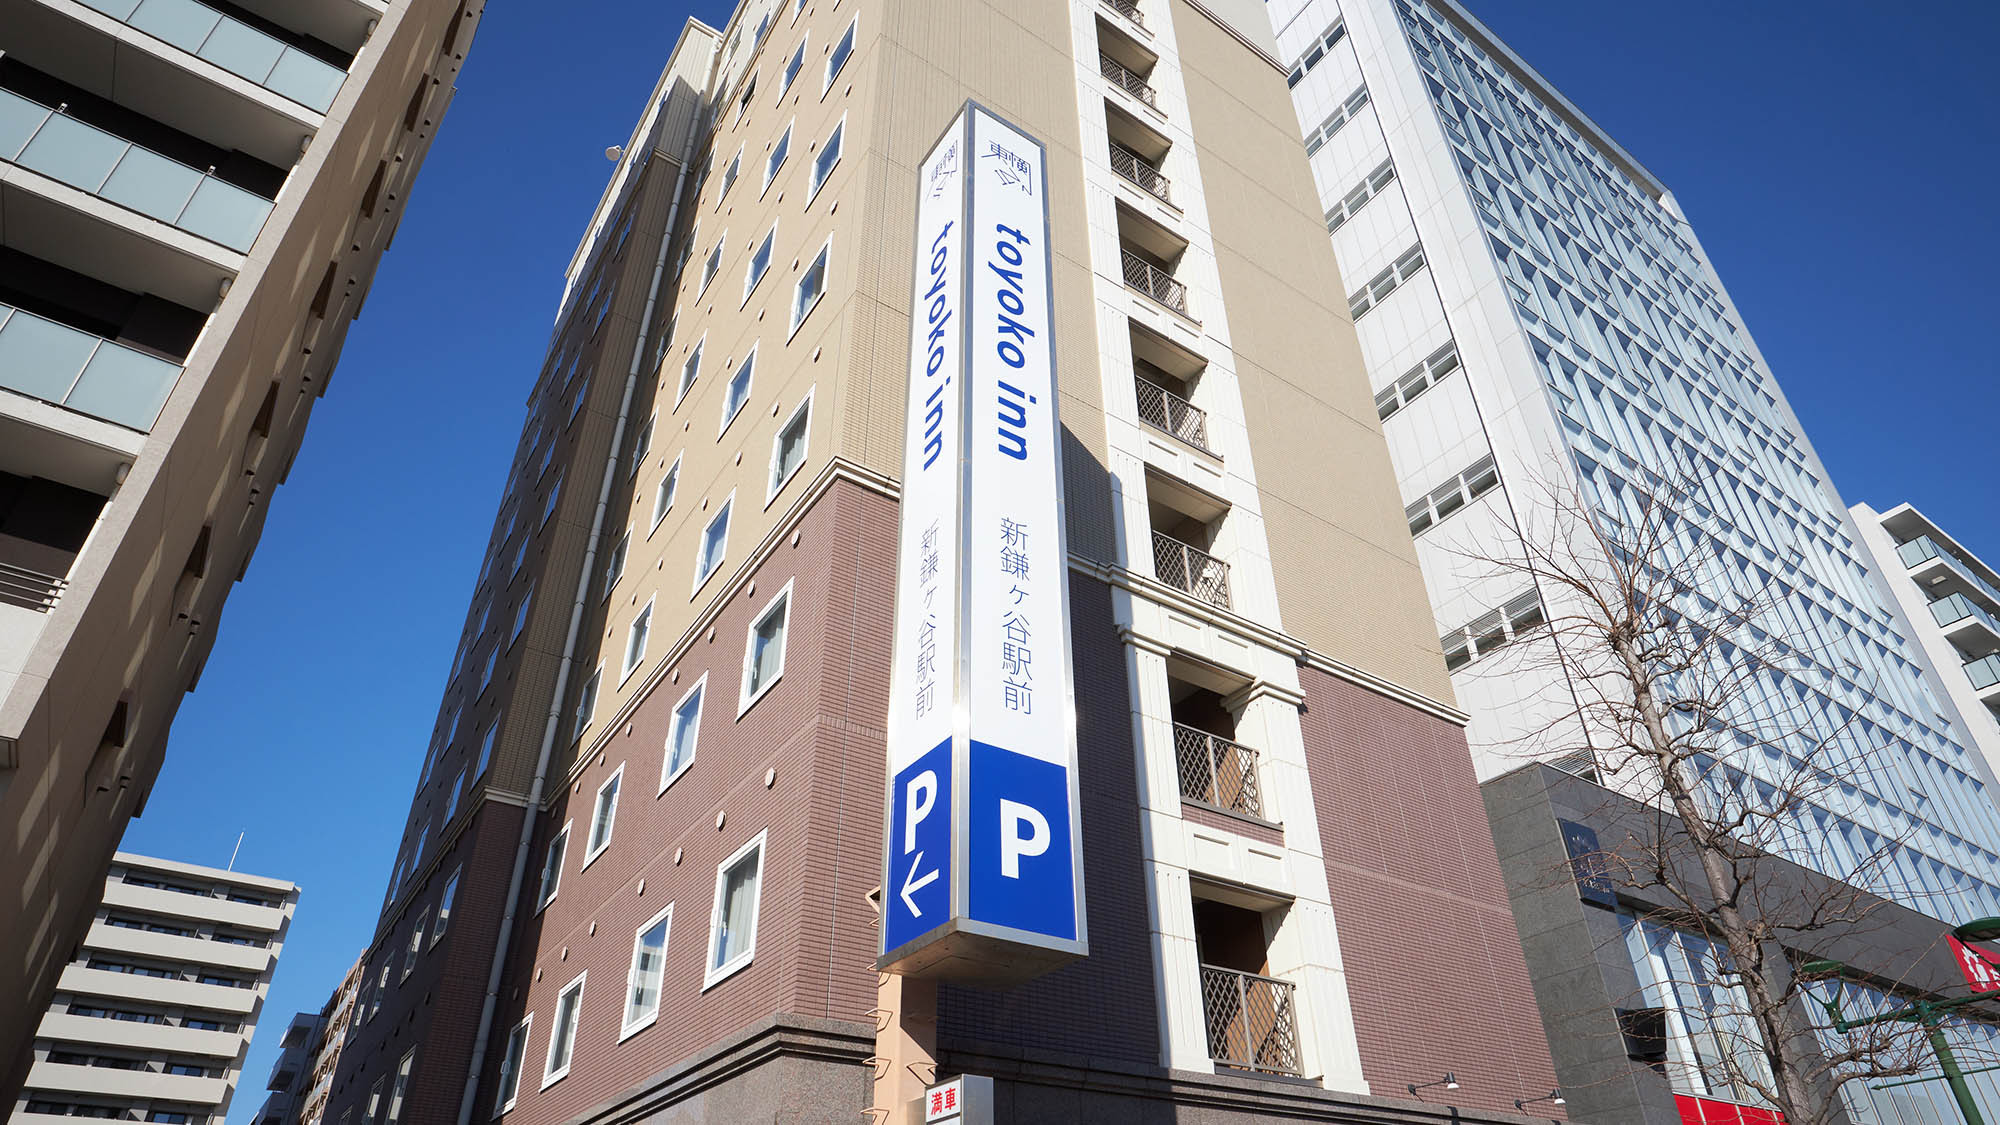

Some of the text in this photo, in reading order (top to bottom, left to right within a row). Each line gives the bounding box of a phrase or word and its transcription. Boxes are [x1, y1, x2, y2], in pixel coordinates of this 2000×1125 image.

[922, 220, 954, 471] toyoko inn
[988, 222, 1037, 461] toyoko inn
[904, 768, 938, 856] P
[1000, 798, 1051, 879] P
[931, 1087, 957, 1115] 満車
